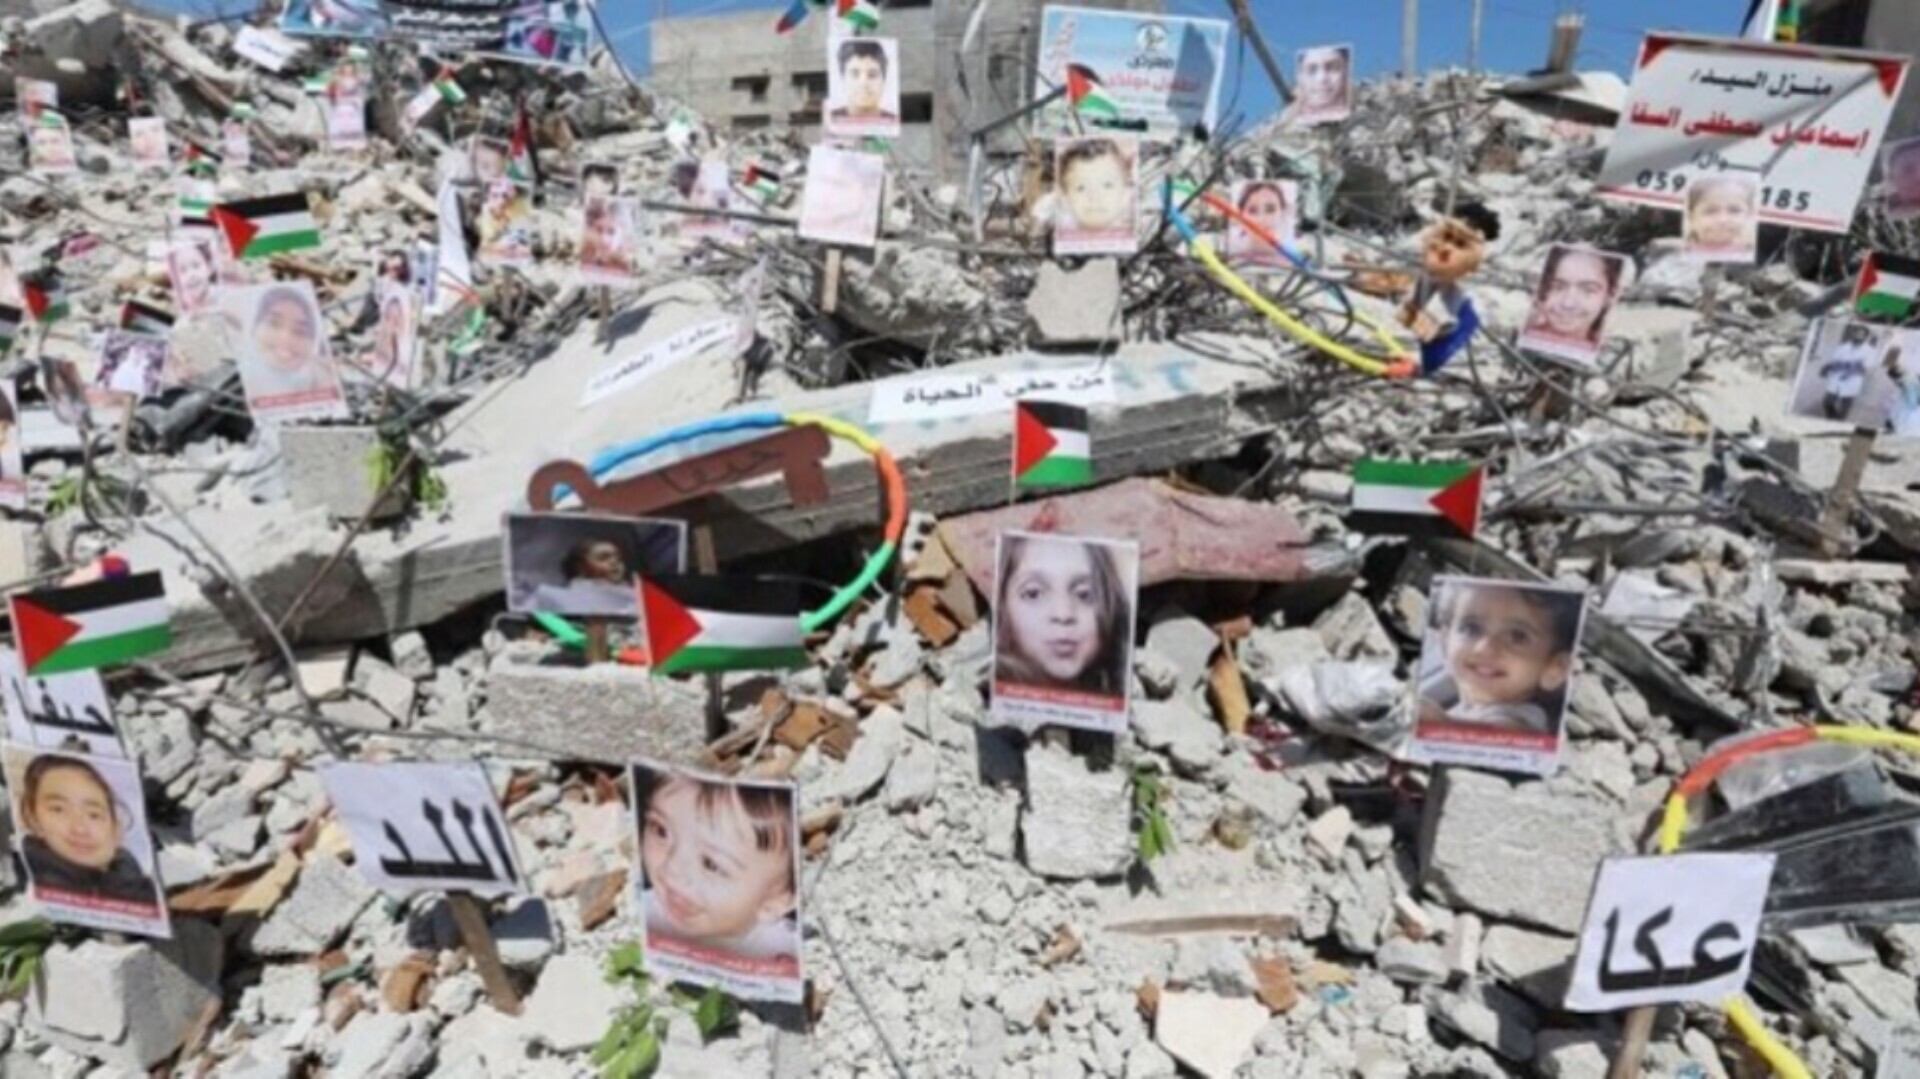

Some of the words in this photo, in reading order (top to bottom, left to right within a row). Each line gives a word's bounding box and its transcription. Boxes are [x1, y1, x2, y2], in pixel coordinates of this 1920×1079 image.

[1767, 72, 1833, 98] منزل
[1683, 110, 1764, 136] مصطفى
[902, 380, 983, 406] الحياة
[11, 676, 116, 752] حيفا
[377, 798, 519, 881] اللد
[1596, 904, 1749, 994] عكا
